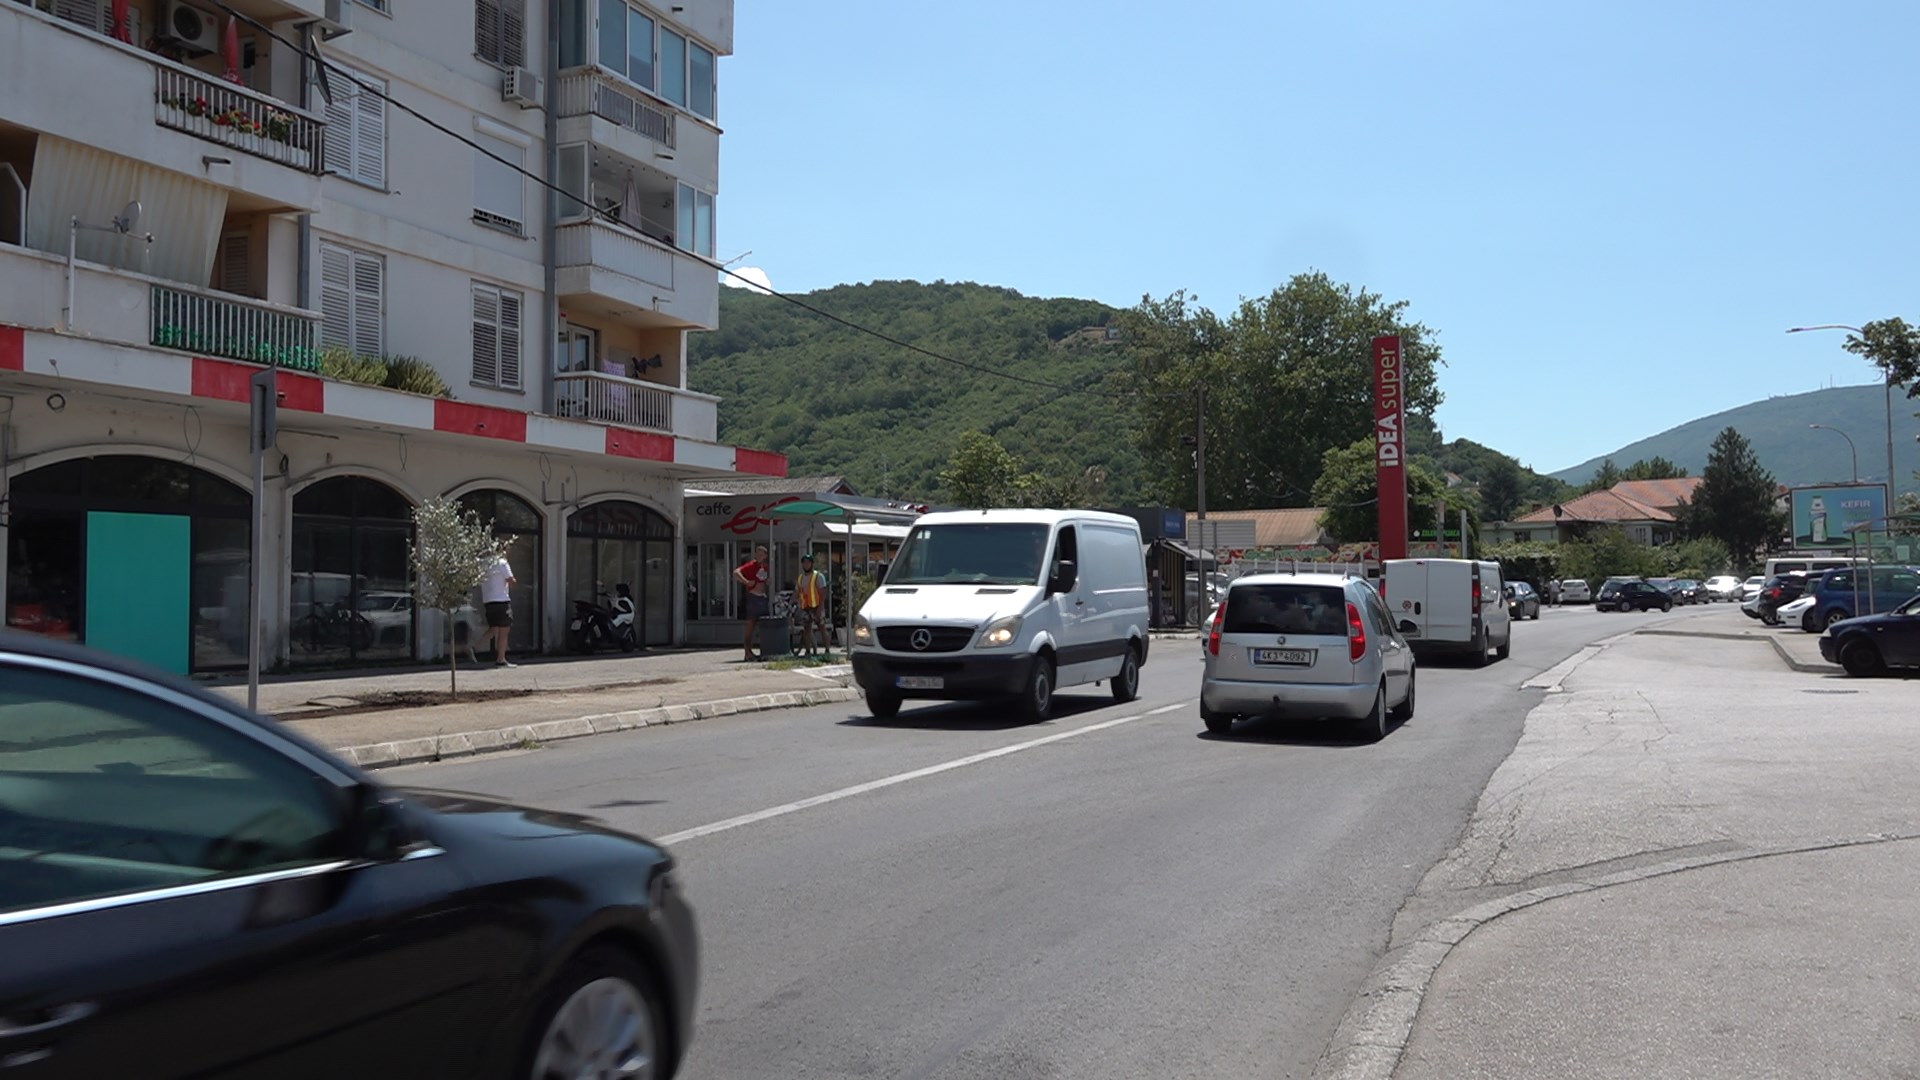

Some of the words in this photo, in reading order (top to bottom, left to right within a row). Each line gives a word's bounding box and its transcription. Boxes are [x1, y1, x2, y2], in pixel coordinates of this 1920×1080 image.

[1381, 347, 1400, 409] super
[696, 502, 732, 516] caffe
[1841, 500, 1871, 508] KEFIR
